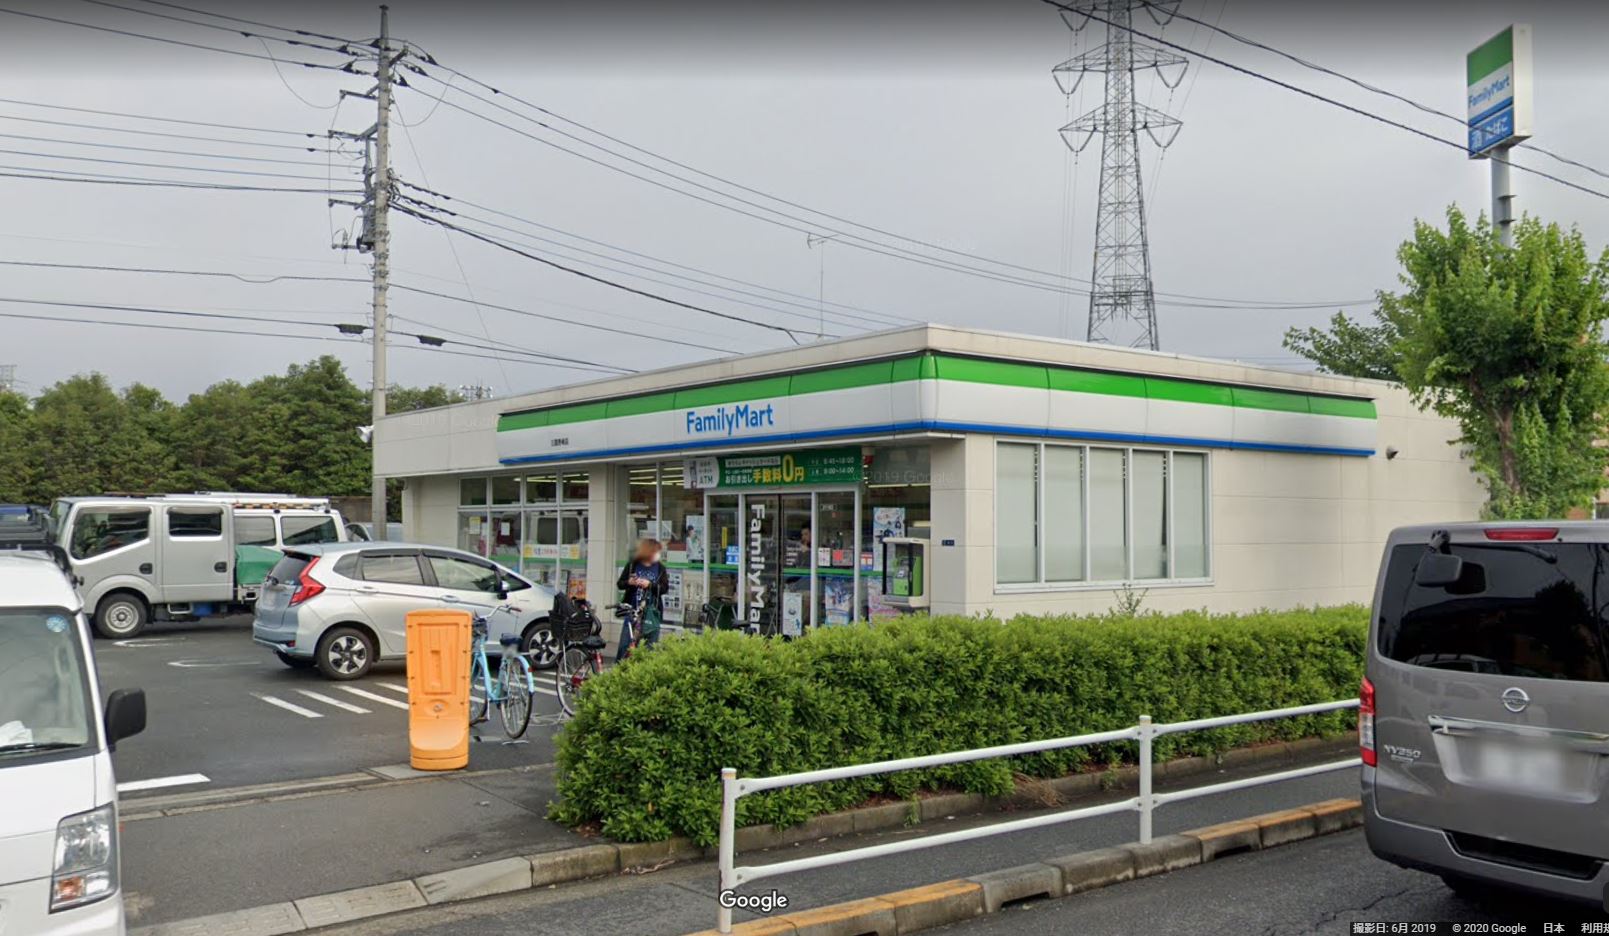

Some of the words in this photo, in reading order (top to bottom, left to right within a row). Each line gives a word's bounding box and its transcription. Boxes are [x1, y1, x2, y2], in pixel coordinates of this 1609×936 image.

[1468, 74, 1510, 108] FamilyMart
[686, 403, 774, 436] FamilyMart
[698, 475, 713, 485] ATM
